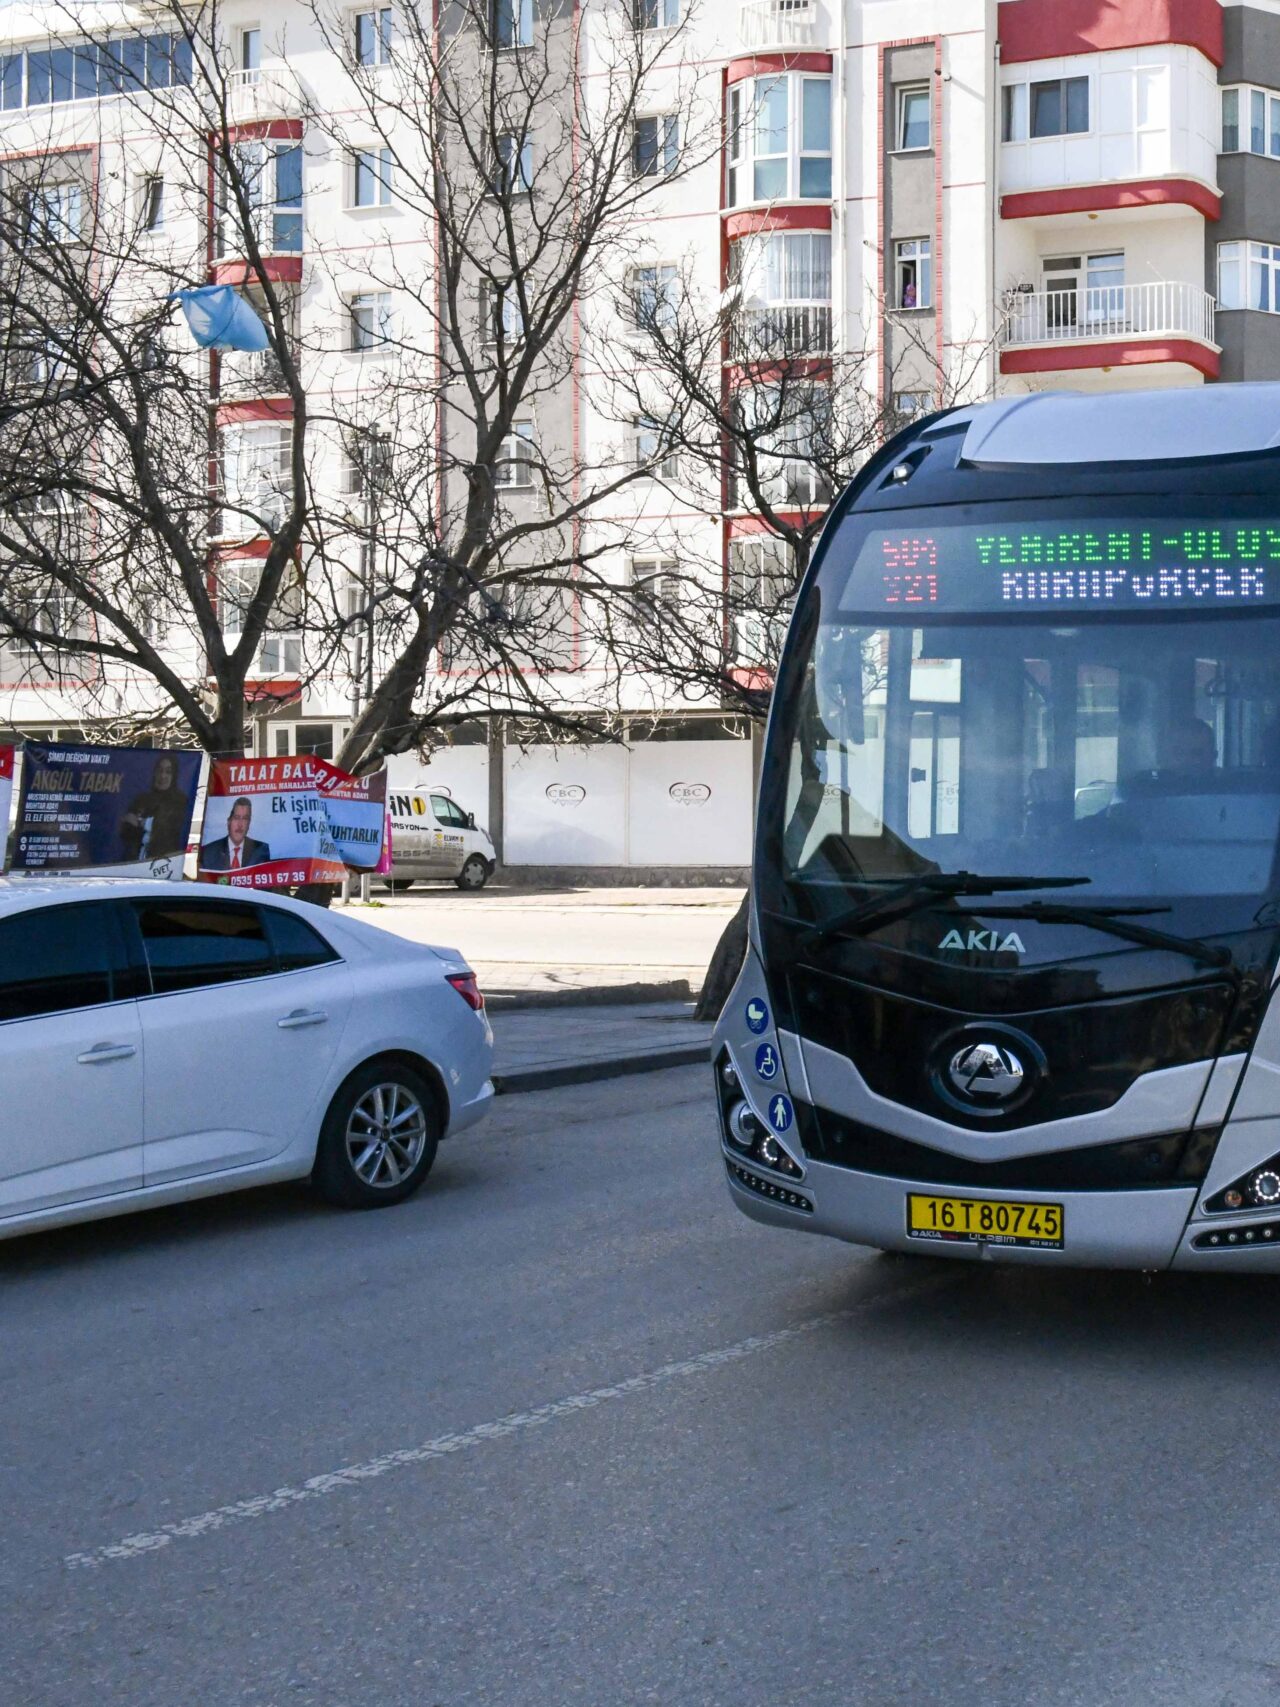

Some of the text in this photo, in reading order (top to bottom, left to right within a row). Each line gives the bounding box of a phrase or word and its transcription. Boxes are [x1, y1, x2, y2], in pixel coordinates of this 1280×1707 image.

[31, 767, 124, 793] AKGÜL TABAK
[230, 765, 277, 782] TALAT
[230, 784, 256, 794] MUSTAFA
[257, 782, 277, 791] KEMAL
[279, 781, 316, 789] MAHALLES
[549, 789, 576, 798] CBC
[672, 788, 701, 797] CBC
[272, 796, 286, 813] Ek
[293, 817, 316, 834] Tek
[153, 864, 169, 877] EVET
[231, 871, 305, 886] 0535 591 67 36
[938, 929, 1026, 953] AKIA
[928, 1201, 1058, 1236] 16 T 80745
[919, 1230, 942, 1239] AKIA
